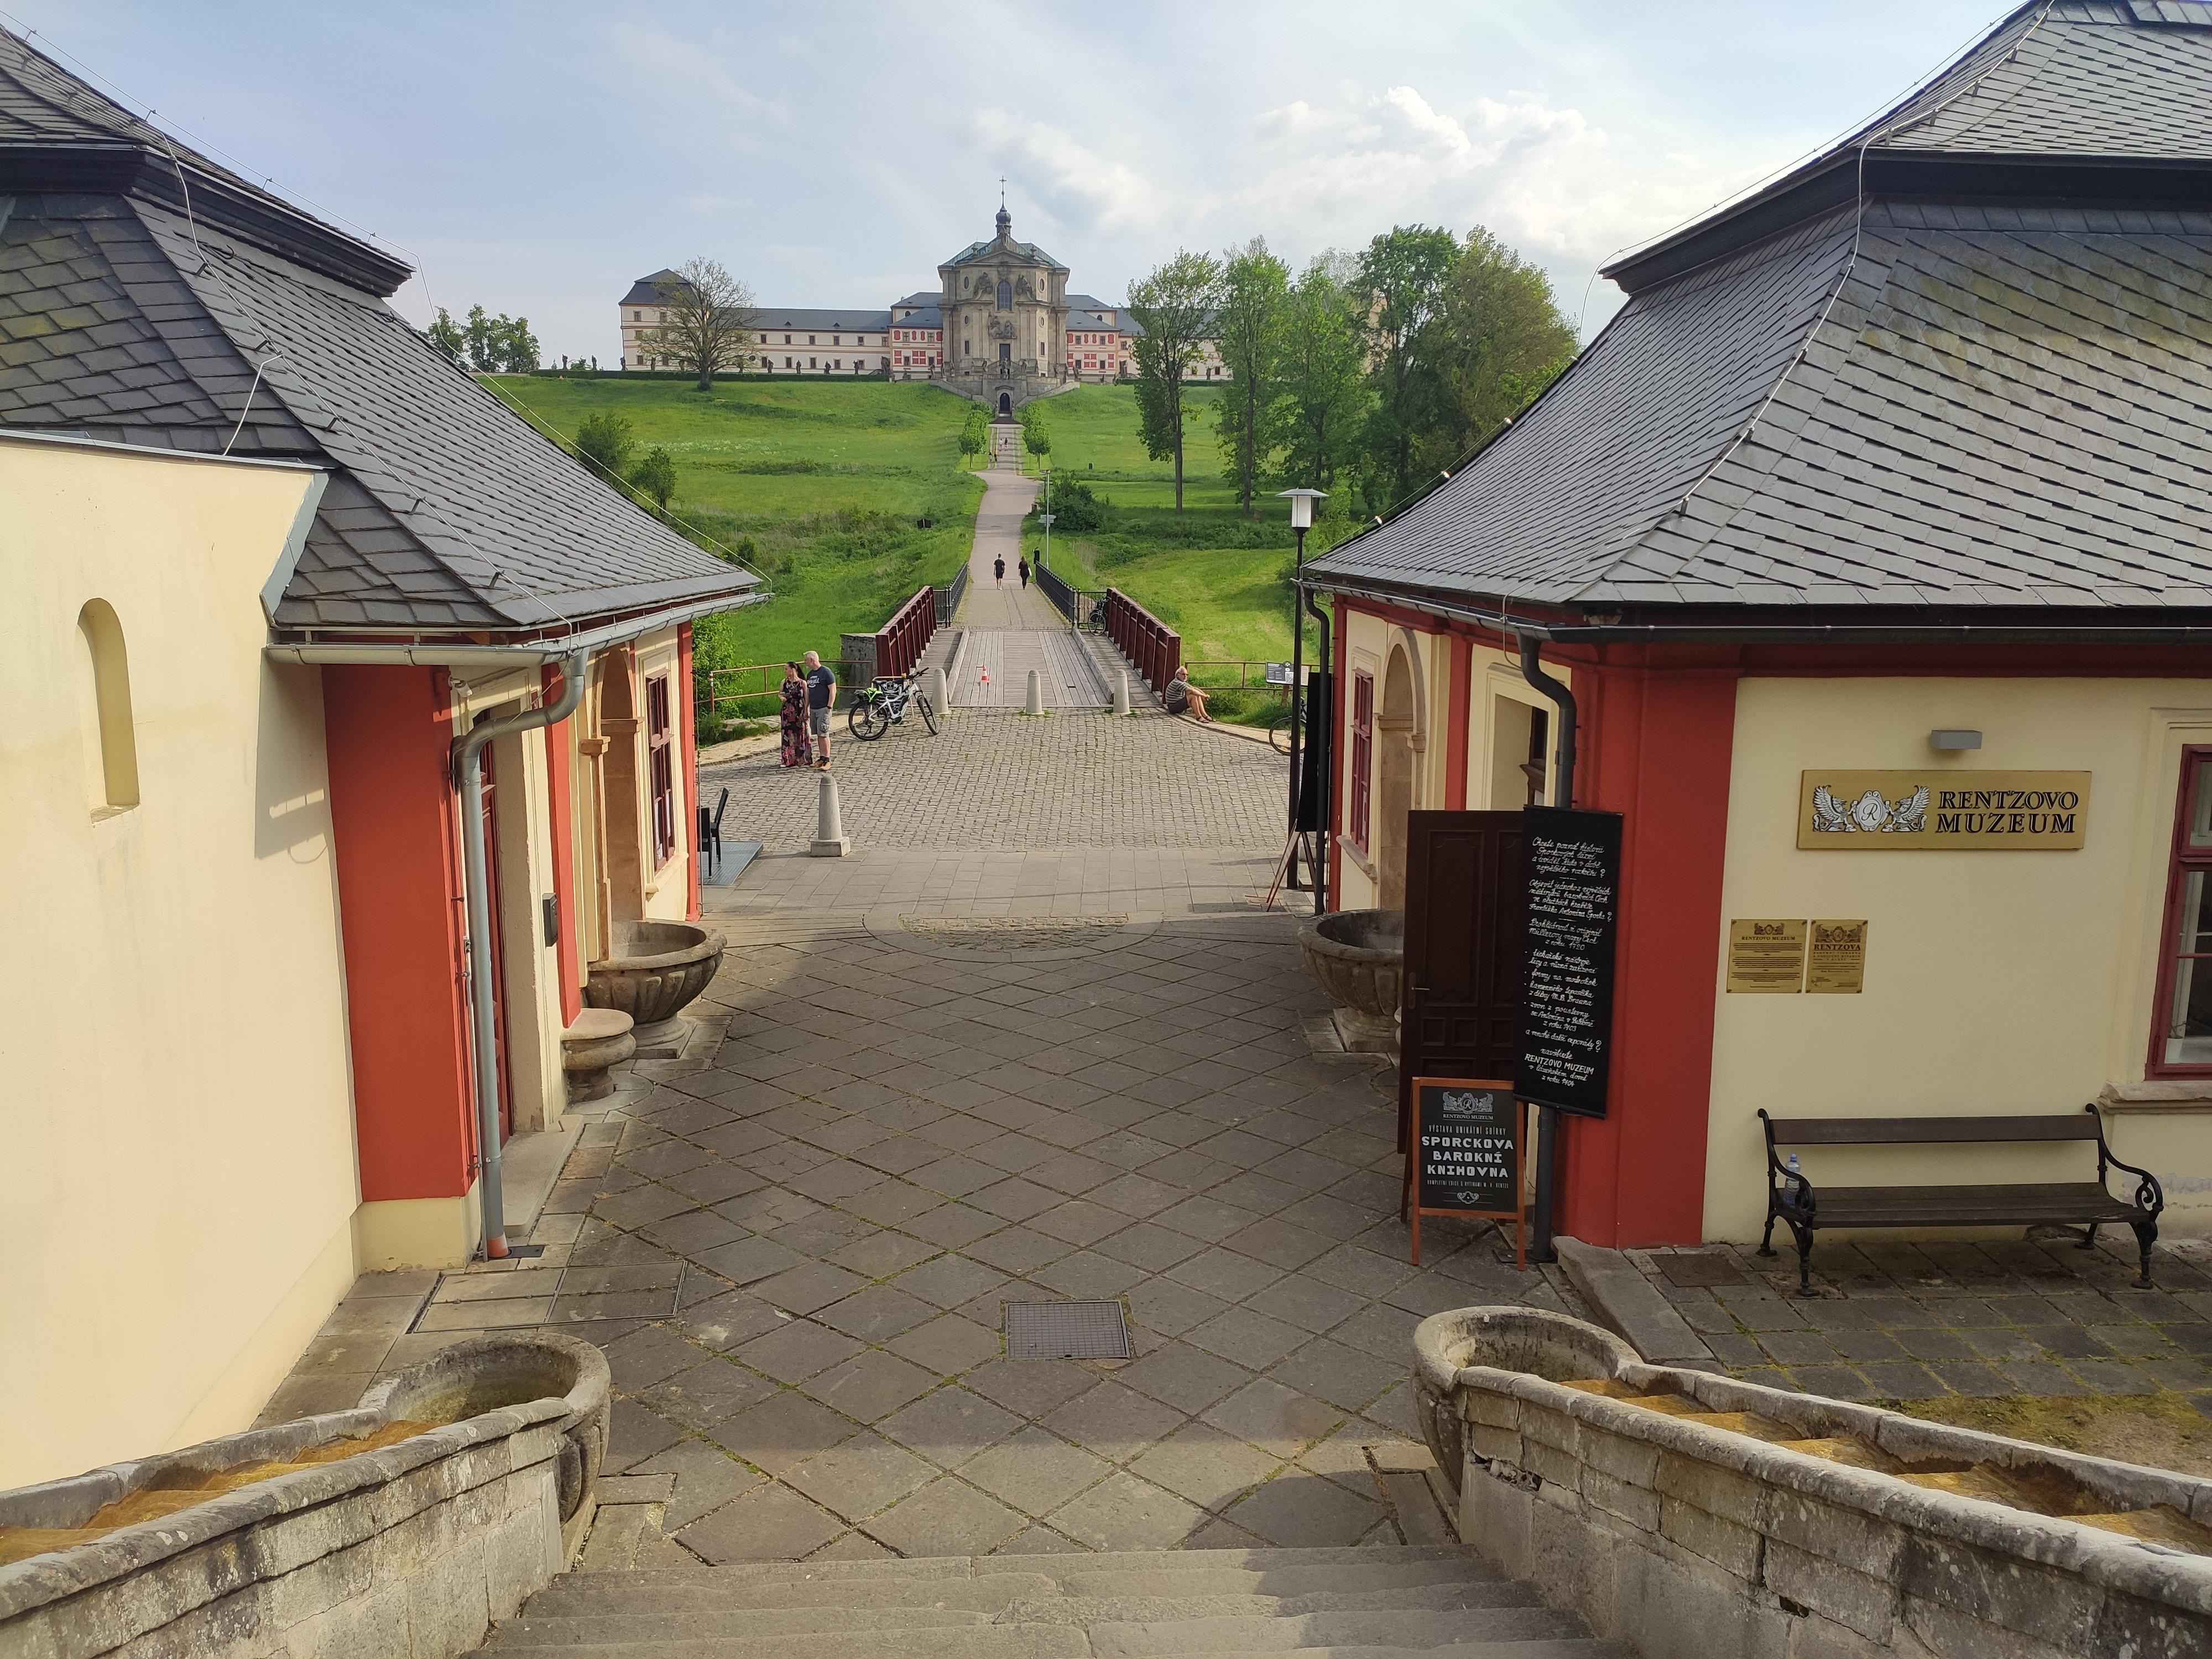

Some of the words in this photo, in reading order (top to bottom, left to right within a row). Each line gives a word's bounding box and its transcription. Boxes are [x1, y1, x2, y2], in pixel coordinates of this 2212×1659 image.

[1938, 790, 2079, 810] RENTZOVO
[1936, 813, 2075, 833] MUZEUM
[1531, 968, 1551, 982] formy
[1525, 1053, 1562, 1068] RENTZOVO
[1564, 1062, 1594, 1074] MUZEUM
[1428, 1124, 1453, 1133] VÝSTAVA
[1455, 1125, 1482, 1134] UNIKÁTNÍ
[1485, 1126, 1506, 1135] SBÍRKY
[1421, 1136, 1514, 1150] SPORCKOVA
[1433, 1150, 1503, 1164] BAROKNÍ
[1427, 1164, 1509, 1178] KNIHOVNA
